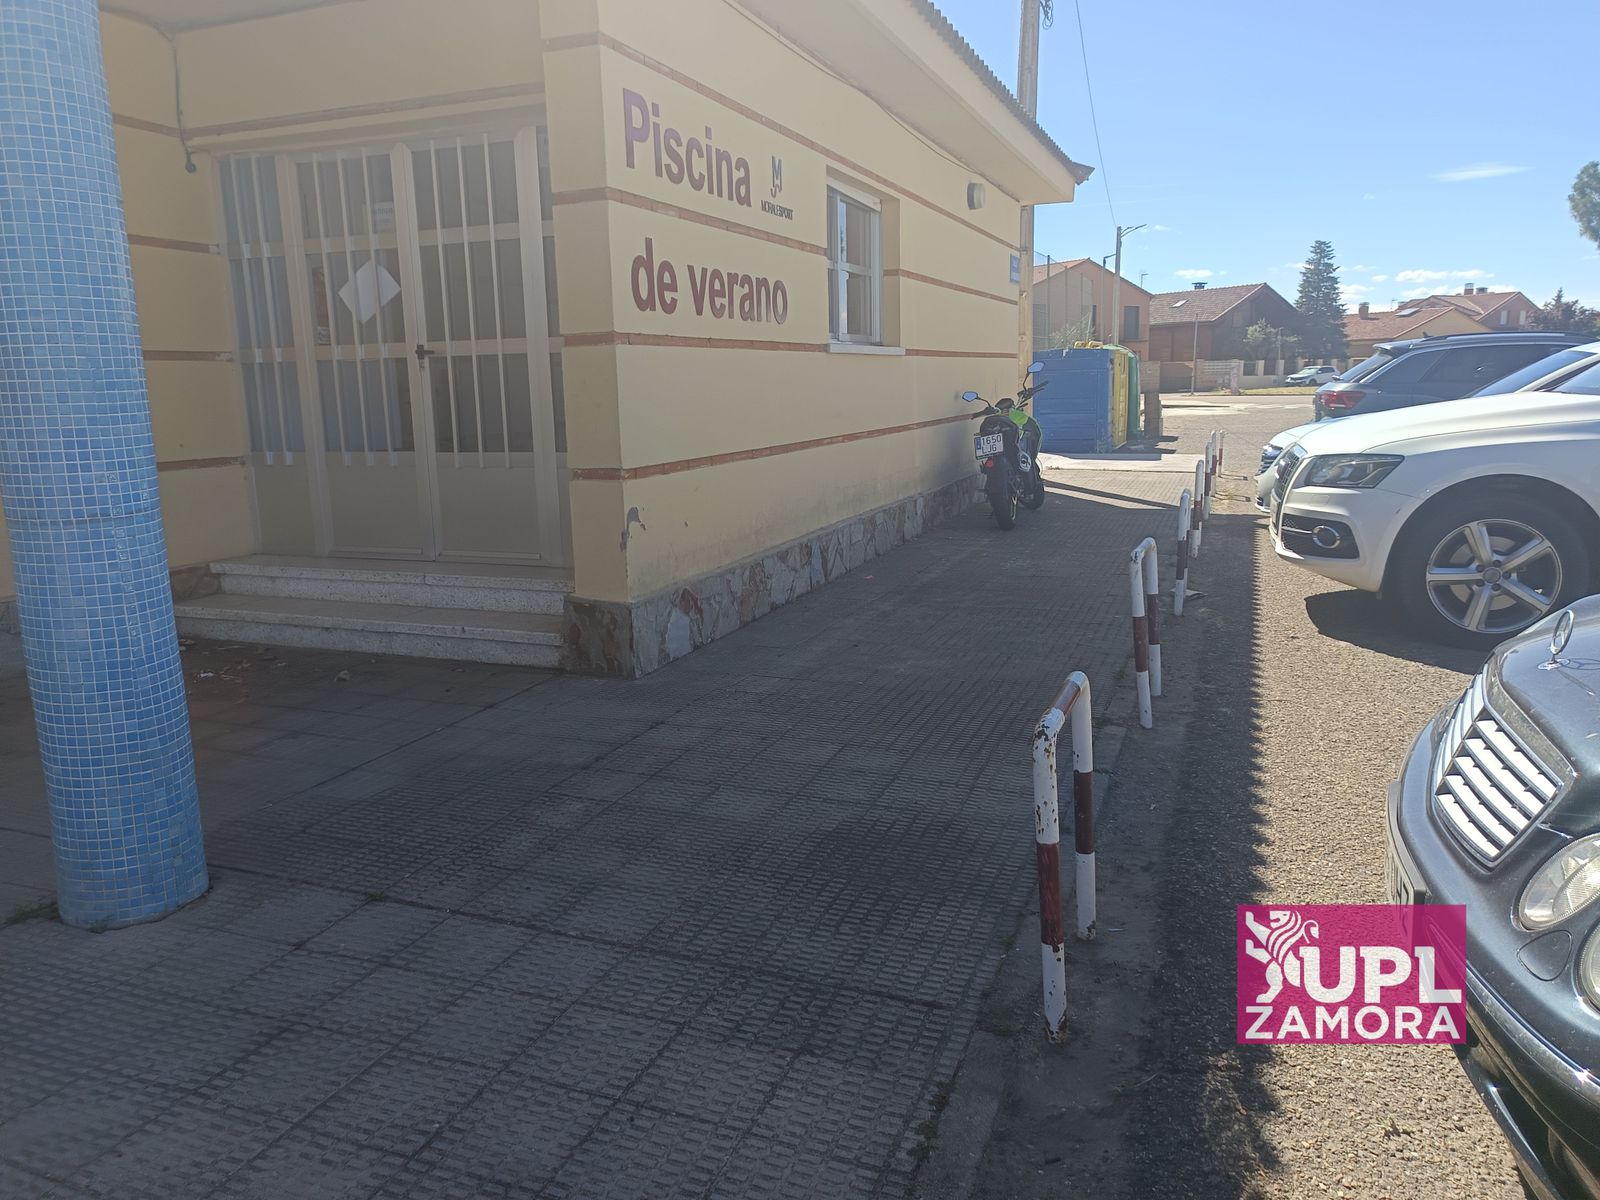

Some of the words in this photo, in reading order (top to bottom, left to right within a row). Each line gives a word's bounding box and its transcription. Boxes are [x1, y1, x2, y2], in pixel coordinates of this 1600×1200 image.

[623, 88, 751, 207] Piscina
[631, 237, 678, 315] de
[687, 264, 788, 325] verano
[982, 434, 1001, 445] 1650
